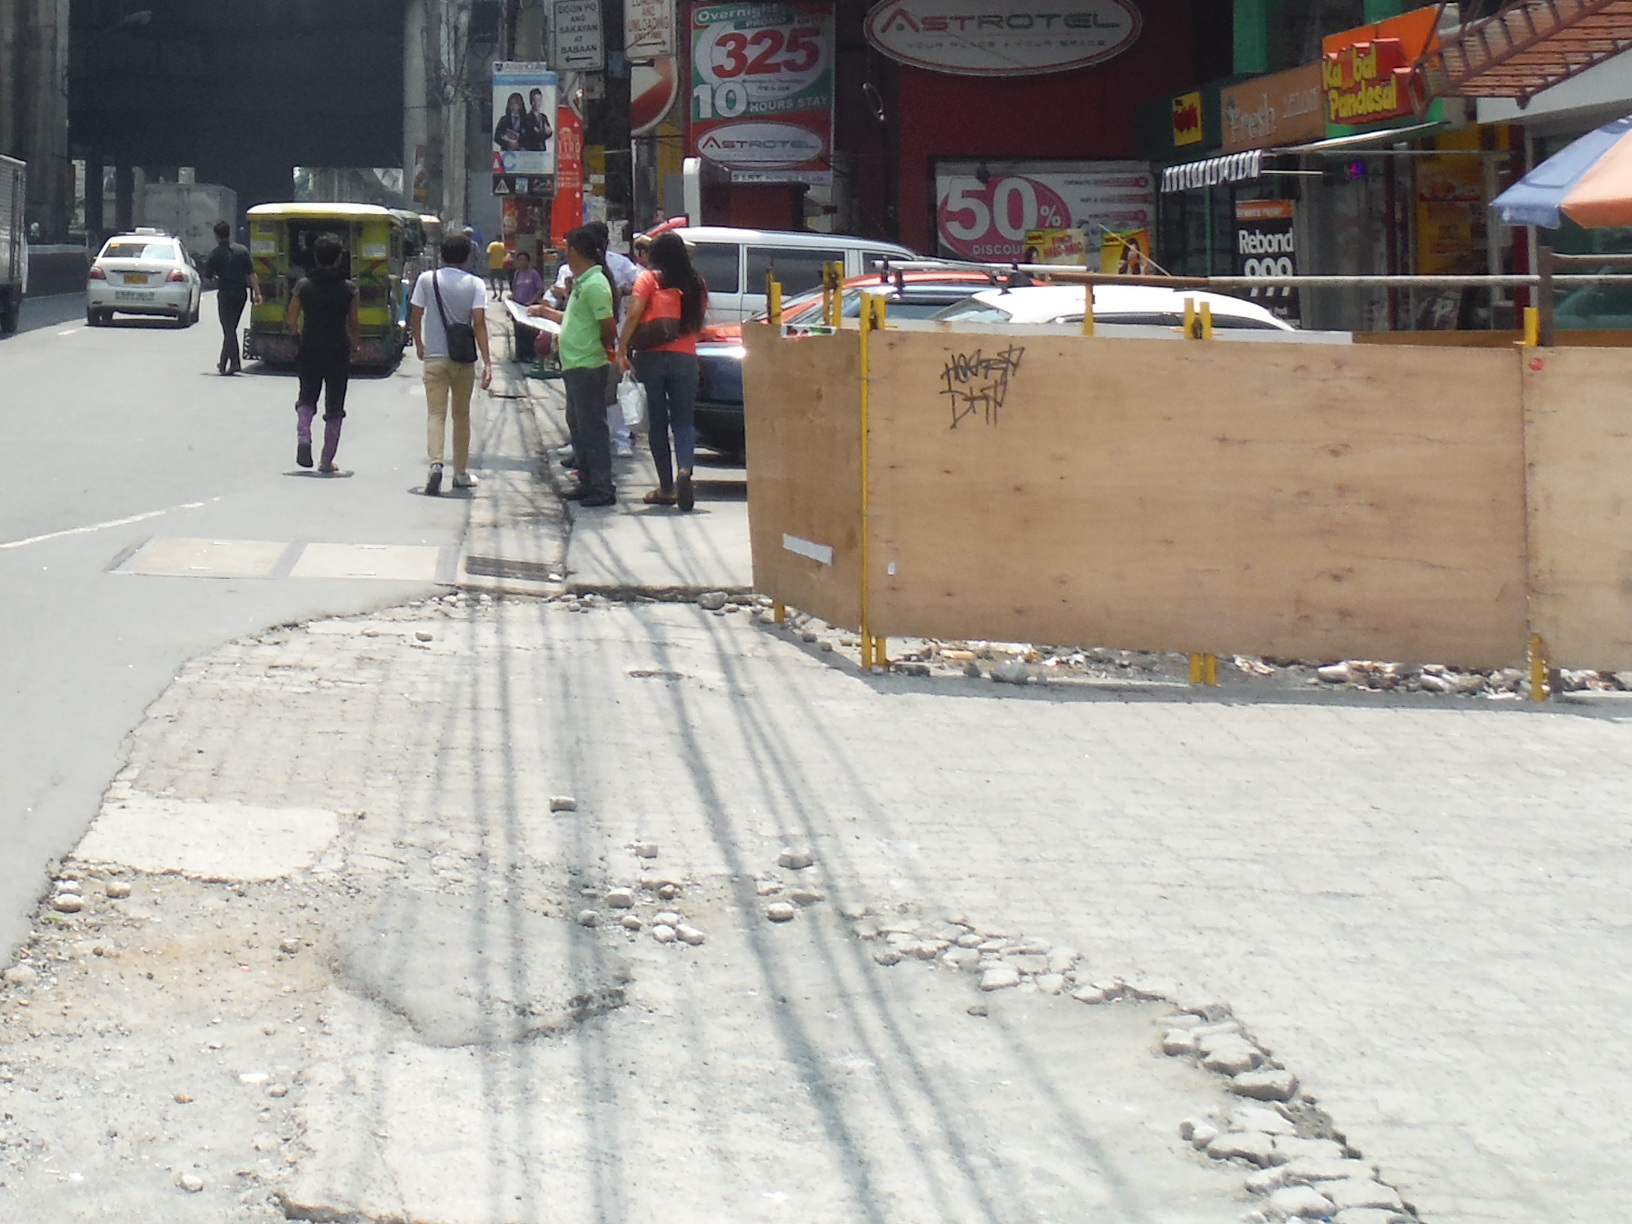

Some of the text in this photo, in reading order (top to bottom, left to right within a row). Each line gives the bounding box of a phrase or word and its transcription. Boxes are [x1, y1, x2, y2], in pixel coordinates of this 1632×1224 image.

[628, 16, 669, 32] UNLOADING
[698, 4, 778, 22] Overnight
[880, 9, 1120, 33] ASTROTEL
[712, 27, 820, 78] 325
[693, 81, 748, 119] 10
[750, 98, 793, 113] HOURS
[796, 96, 828, 107] STAY
[1329, 73, 1397, 121] Pandesal
[702, 136, 818, 150] ASTROTEL
[1238, 227, 1294, 255] Rebond
[1244, 257, 1294, 297] 999
